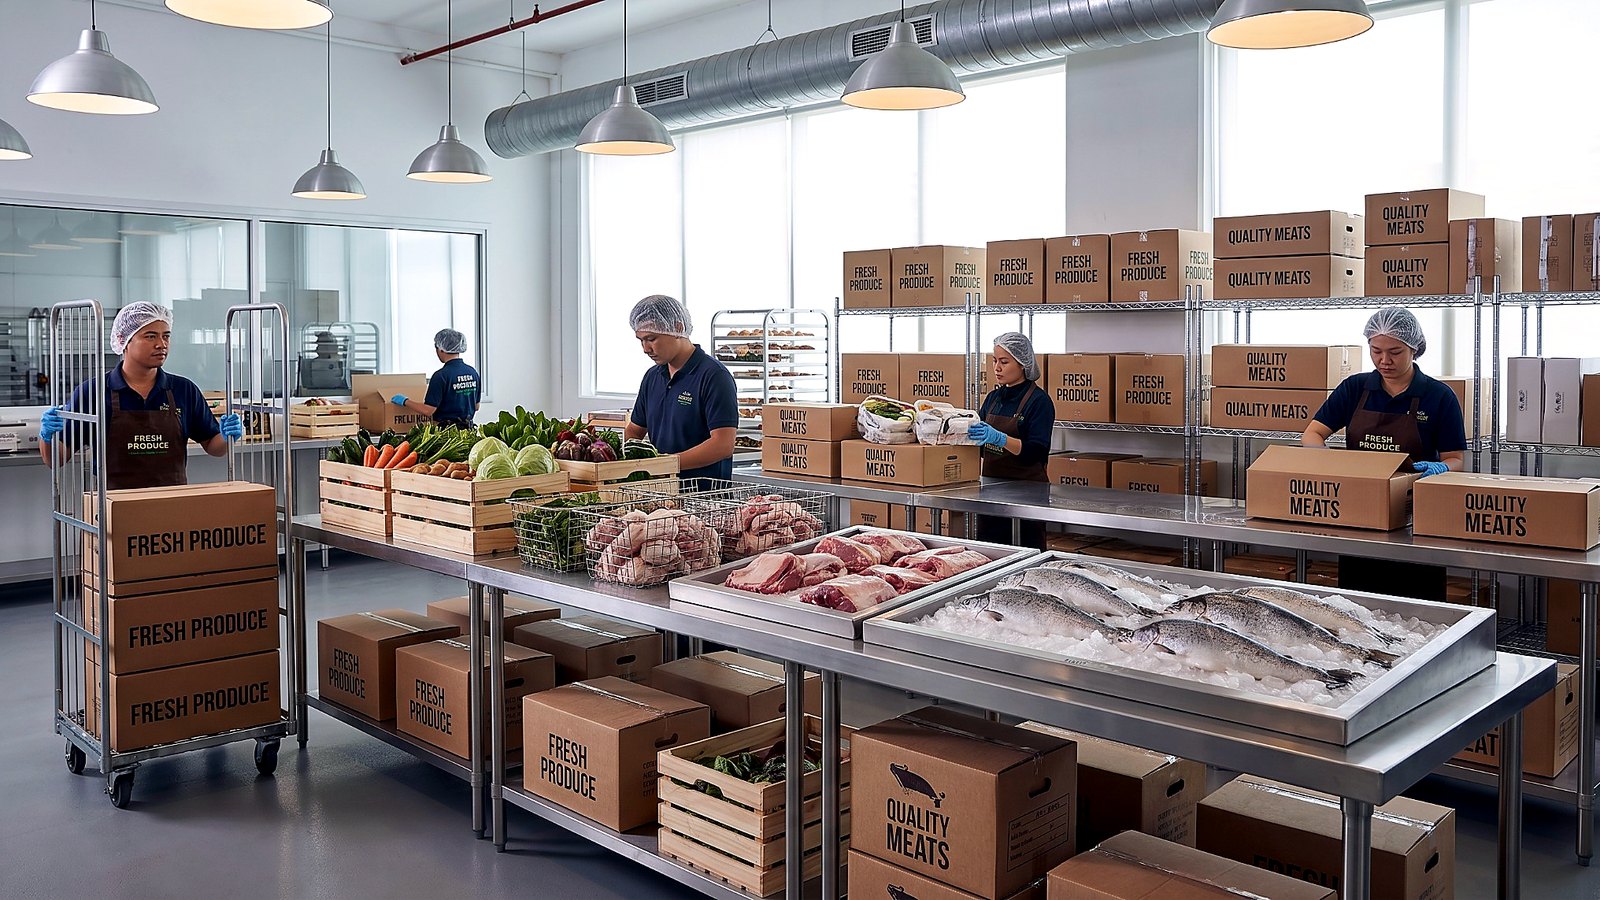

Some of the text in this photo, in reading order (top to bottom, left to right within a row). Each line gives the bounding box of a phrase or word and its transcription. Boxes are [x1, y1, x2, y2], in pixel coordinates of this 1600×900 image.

[1383, 204, 1429, 221] QUALITY
[1229, 225, 1311, 245] QUALITY MEATS
[1387, 220, 1424, 235] MEATS
[1000, 258, 1027, 272] FRESH
[1062, 254, 1091, 269] FRESH
[1128, 251, 1159, 266] FRESH
[1190, 250, 1209, 265] FRESH
[855, 266, 877, 278] FRESH
[905, 263, 929, 276] FRESH
[955, 262, 976, 275] FRESH
[1121, 266, 1167, 281] PRODUCE
[1185, 265, 1212, 280] PRODUCE
[1382, 258, 1429, 274] QUALITY
[899, 276, 934, 289] PRODUCE
[950, 276, 981, 288] PRODUCE
[994, 272, 1033, 286] PRODUCE
[1055, 269, 1098, 284] PRODUCE
[1228, 270, 1311, 288] QUALITY MEATS
[1387, 274, 1424, 288] MEATS
[850, 278, 883, 291] PRODUCE
[1247, 352, 1287, 366] QUALITY
[857, 369, 881, 381] FRESH
[919, 370, 944, 383] FRESH
[1063, 374, 1092, 387] FRESH
[1133, 375, 1164, 389] FRESH
[1249, 367, 1286, 382] MEATS
[852, 382, 887, 395] PRODUCE
[913, 384, 950, 397] PRODUCE
[1057, 388, 1099, 402] PRODUCE
[1125, 390, 1171, 405] PRODUCE
[780, 409, 807, 421] QUALITY
[1226, 402, 1308, 419] QUALITY MEATS
[781, 421, 807, 435] MEATS
[1359, 441, 1400, 451] PRODUCE
[1365, 434, 1393, 443] FRESH
[781, 442, 808, 455] QUALITY
[866, 448, 896, 462] QUALITY
[782, 455, 807, 469] MEATS
[866, 462, 895, 478] MEATS
[1060, 476, 1089, 486] FRESH
[1129, 482, 1159, 493] FRESH
[1290, 479, 1340, 497] QUALITY
[1290, 497, 1340, 519] MEATS
[1465, 493, 1527, 513] QUALITY
[1466, 512, 1526, 537] MEATS
[127, 524, 266, 557] FRESH PRODUCE
[129, 620, 186, 648] FRESH
[191, 608, 268, 639] PRODUCE
[334, 648, 359, 675] FRESH
[329, 667, 365, 699] PRODUCE
[416, 678, 445, 706] FRESH
[131, 696, 188, 726] FRESH
[193, 681, 270, 714] PRODUCE
[410, 699, 452, 735] PRODUCE
[549, 733, 587, 770] FRESH
[541, 756, 596, 801] PRODUCE
[887, 798, 950, 838] QUALITY
[887, 823, 949, 870] MEATS
